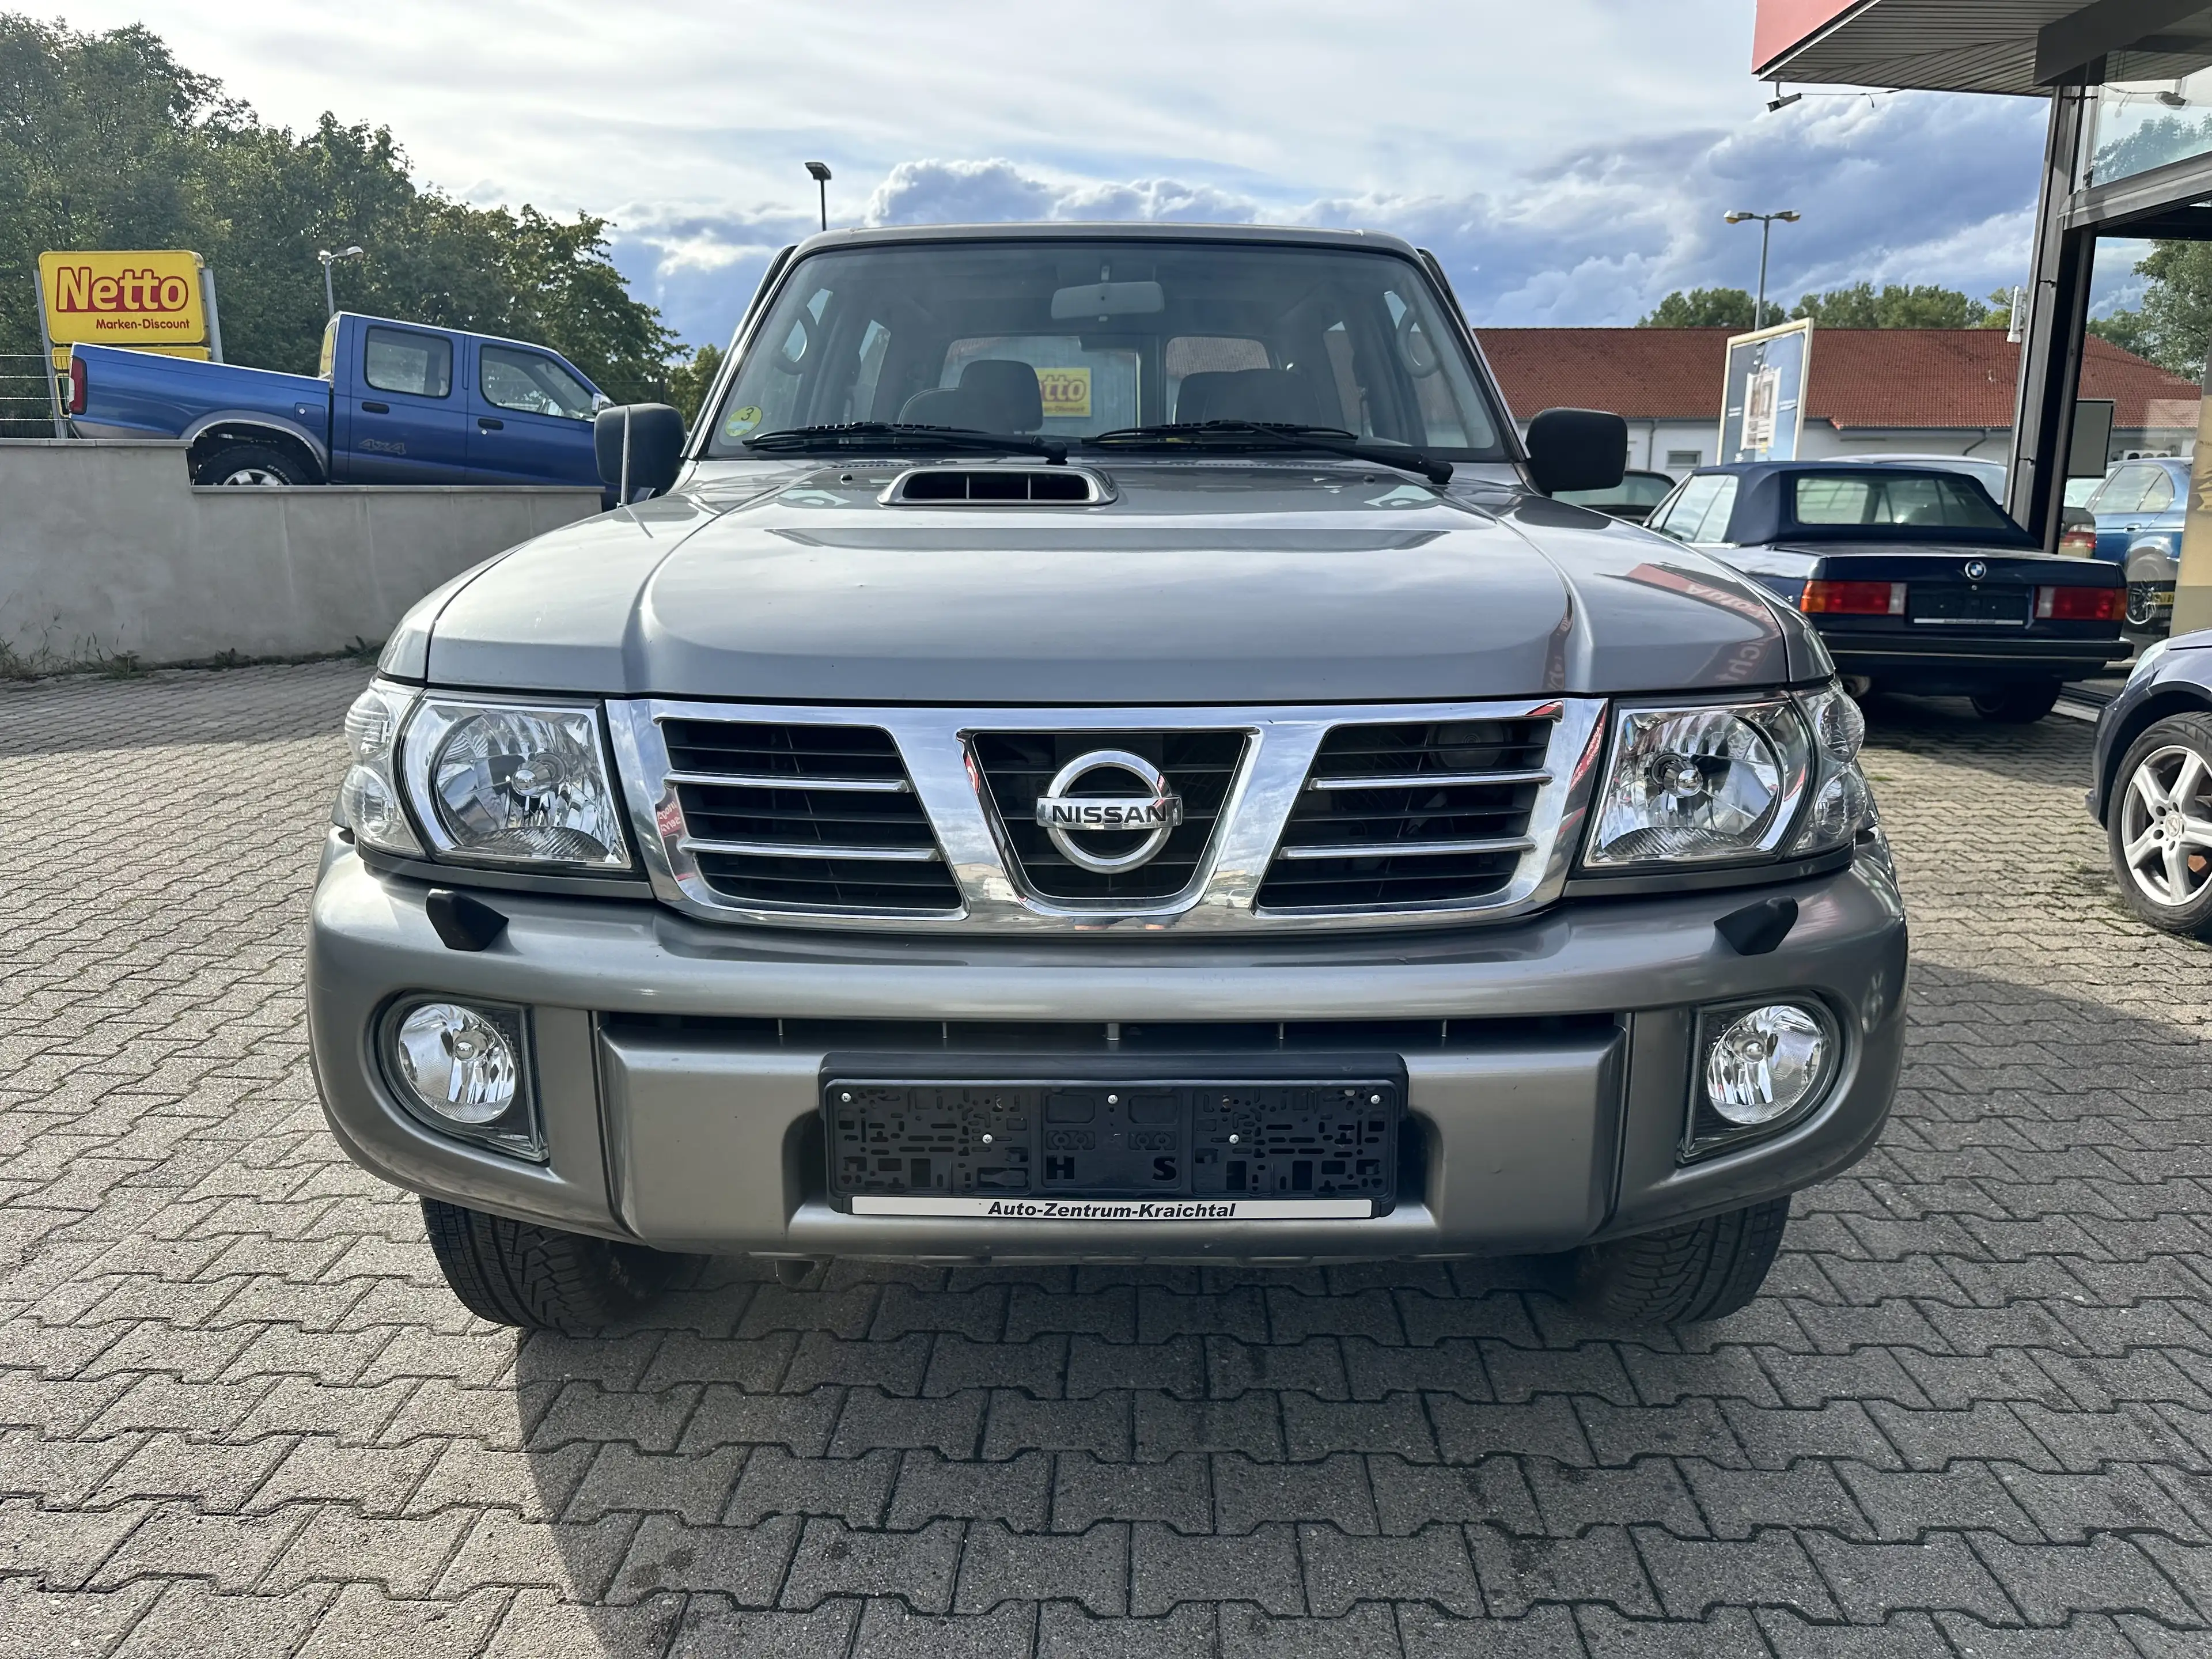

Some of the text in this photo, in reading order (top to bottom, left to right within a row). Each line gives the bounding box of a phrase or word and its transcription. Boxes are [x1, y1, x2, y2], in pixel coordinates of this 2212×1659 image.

[56, 267, 189, 312] Netto
[96, 319, 190, 329] Marken-Discount
[1040, 374, 1087, 403] tto
[741, 407, 755, 421] 3
[358, 438, 407, 455] 4x4
[1052, 805, 1167, 824] NISSAN
[988, 1201, 1236, 1218] Auto-Zentrum-Kraichtal
